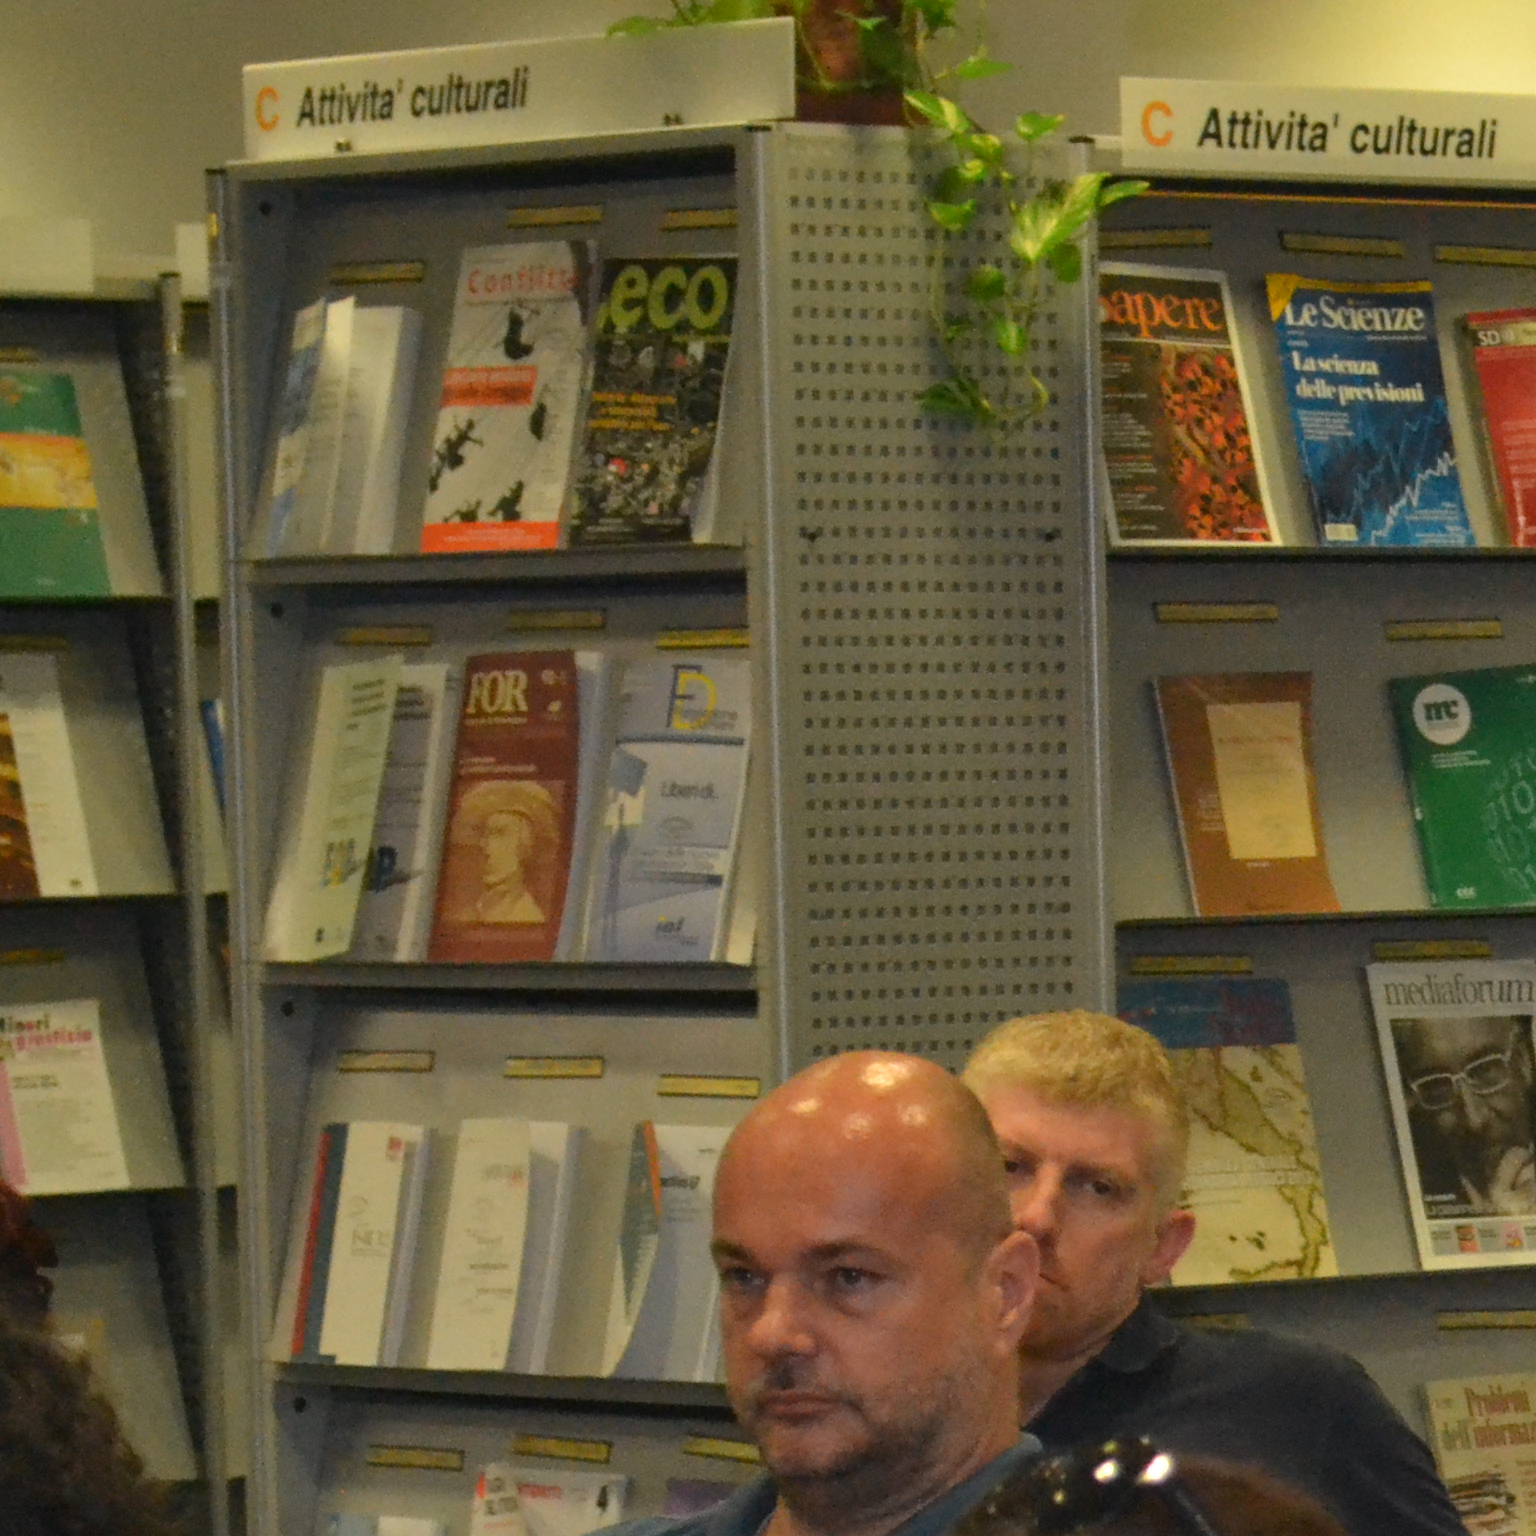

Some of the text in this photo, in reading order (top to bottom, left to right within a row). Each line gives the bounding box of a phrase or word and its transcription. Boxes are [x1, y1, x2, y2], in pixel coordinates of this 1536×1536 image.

[254, 65, 531, 131] C Attivita' culturali
[1141, 100, 1498, 159] C Attivita' culturali
[1318, 295, 1425, 332] Scienze
[1383, 973, 1536, 1006] mediaforum
